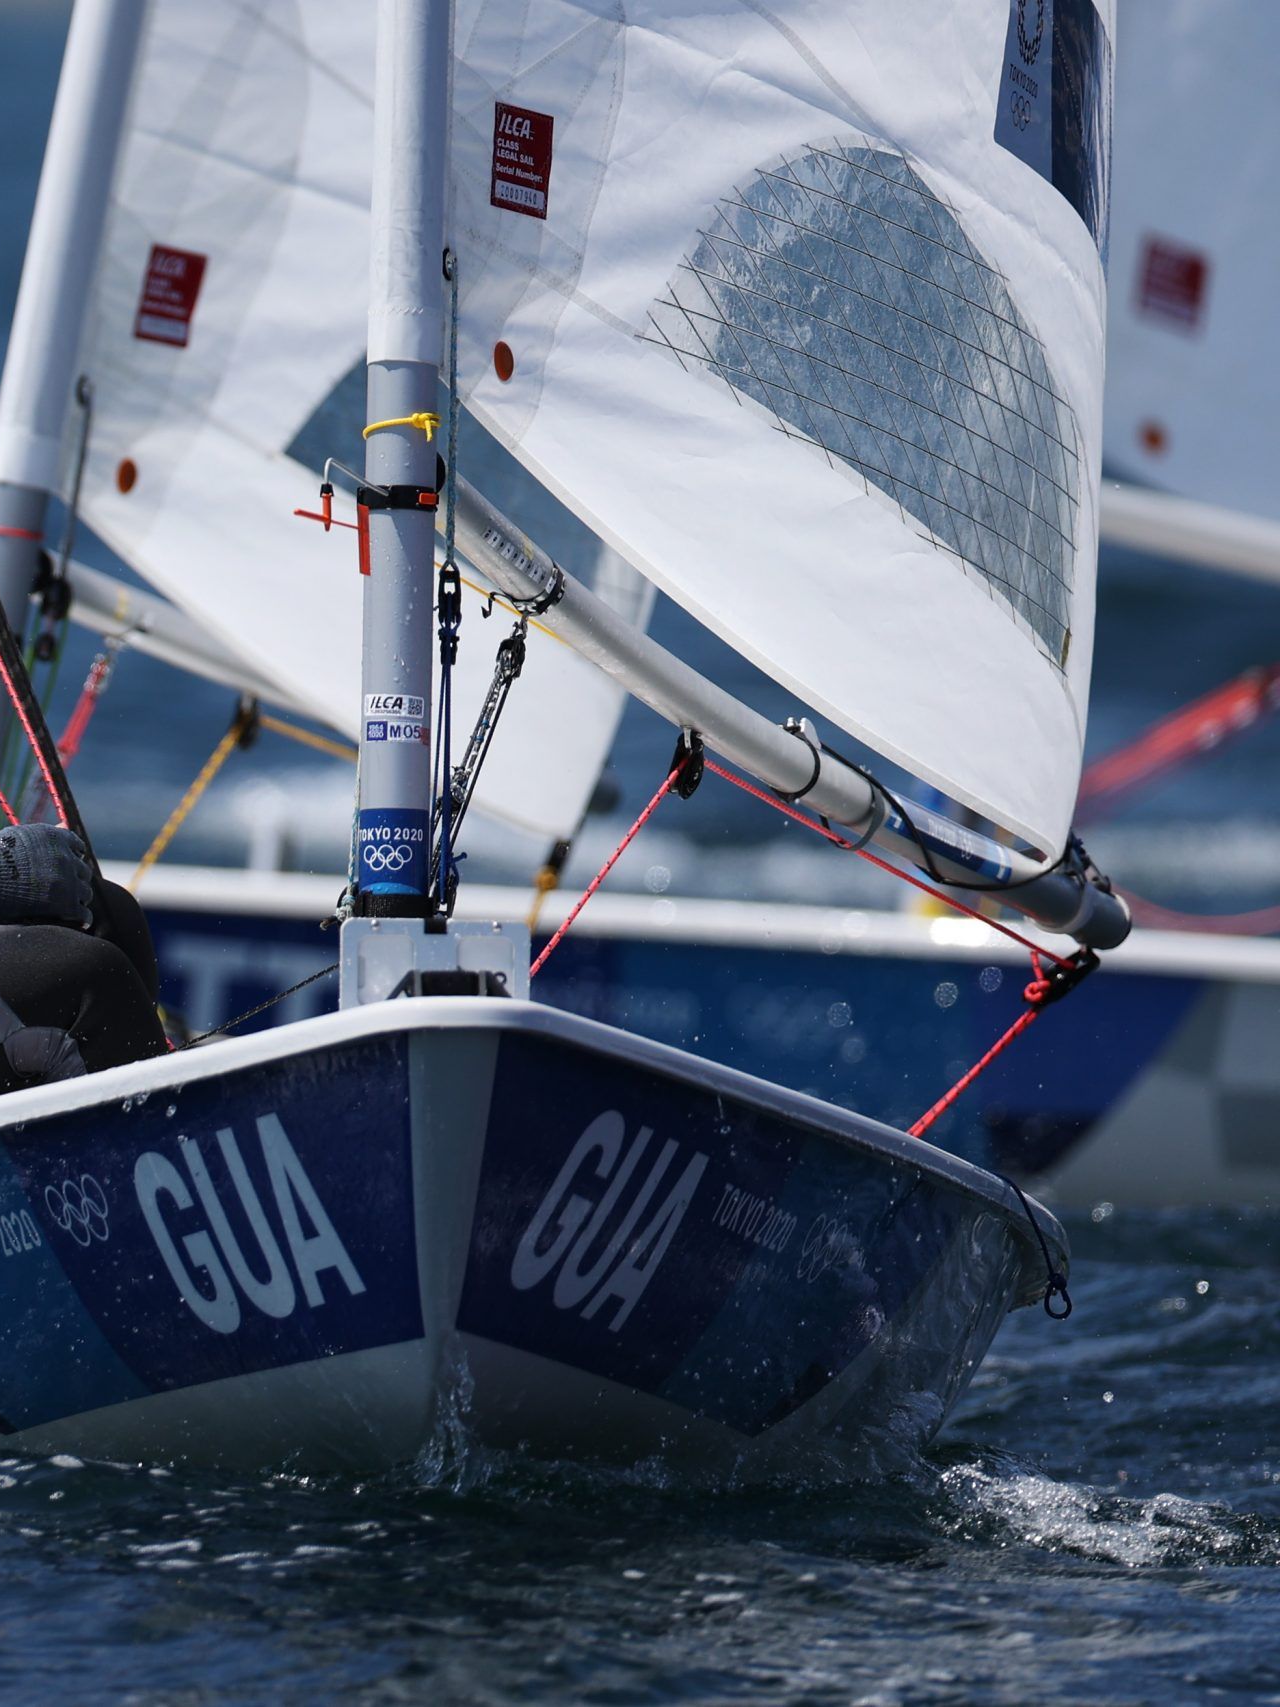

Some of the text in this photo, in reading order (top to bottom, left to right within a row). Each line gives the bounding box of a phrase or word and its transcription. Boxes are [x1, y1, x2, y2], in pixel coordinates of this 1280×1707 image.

[1009, 64, 1038, 98] TOKYO 2020
[498, 113, 531, 139] ILCA
[497, 138, 519, 151] CLASS
[496, 148, 534, 166] LEGAL SAIL
[496, 163, 543, 182] Serial Number:
[370, 696, 403, 710] ILCA
[393, 827, 424, 841] 2020
[134, 1112, 367, 1335] GUA
[511, 1109, 710, 1333] GUA
[712, 1183, 798, 1253] TOKYO 2020
